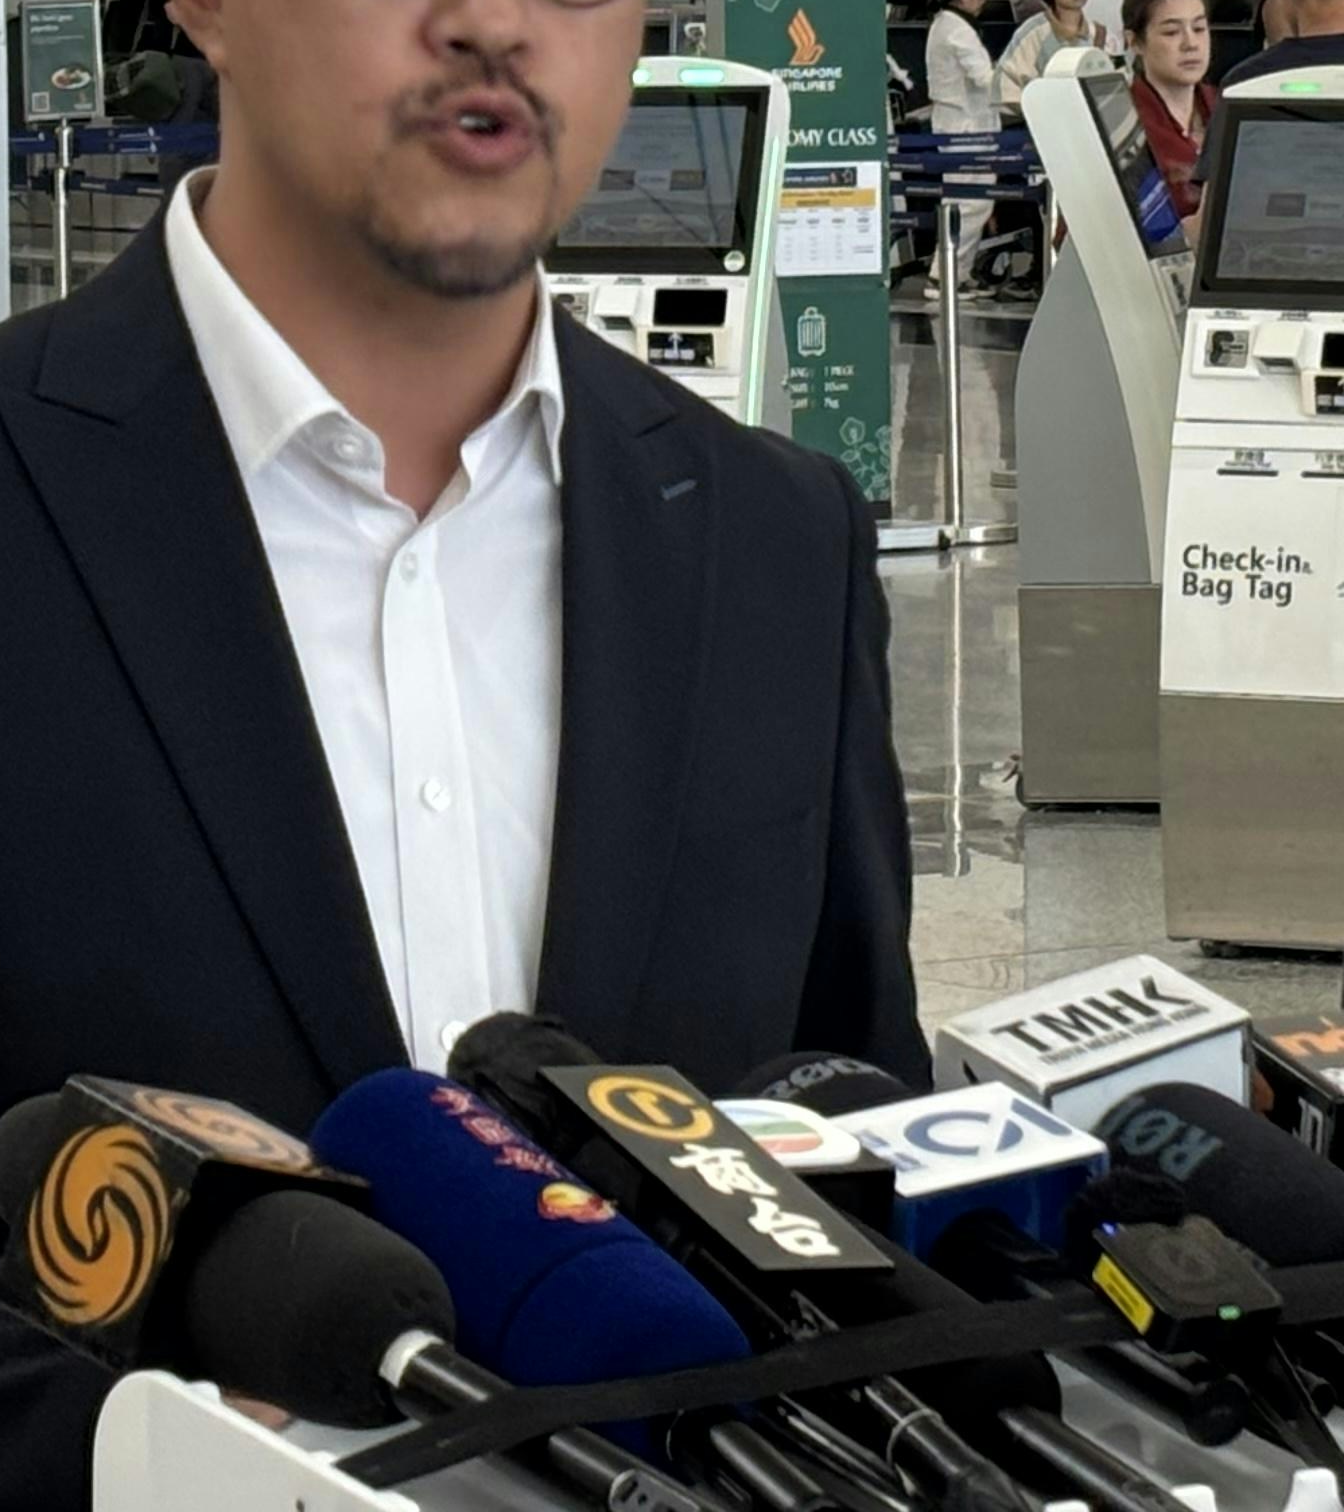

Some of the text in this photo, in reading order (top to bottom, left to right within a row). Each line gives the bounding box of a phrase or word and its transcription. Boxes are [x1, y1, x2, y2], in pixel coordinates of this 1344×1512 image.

[827, 127, 877, 147] CLASS
[1181, 572, 1292, 608] Bag Tag
[990, 975, 1194, 1052] TMHK
